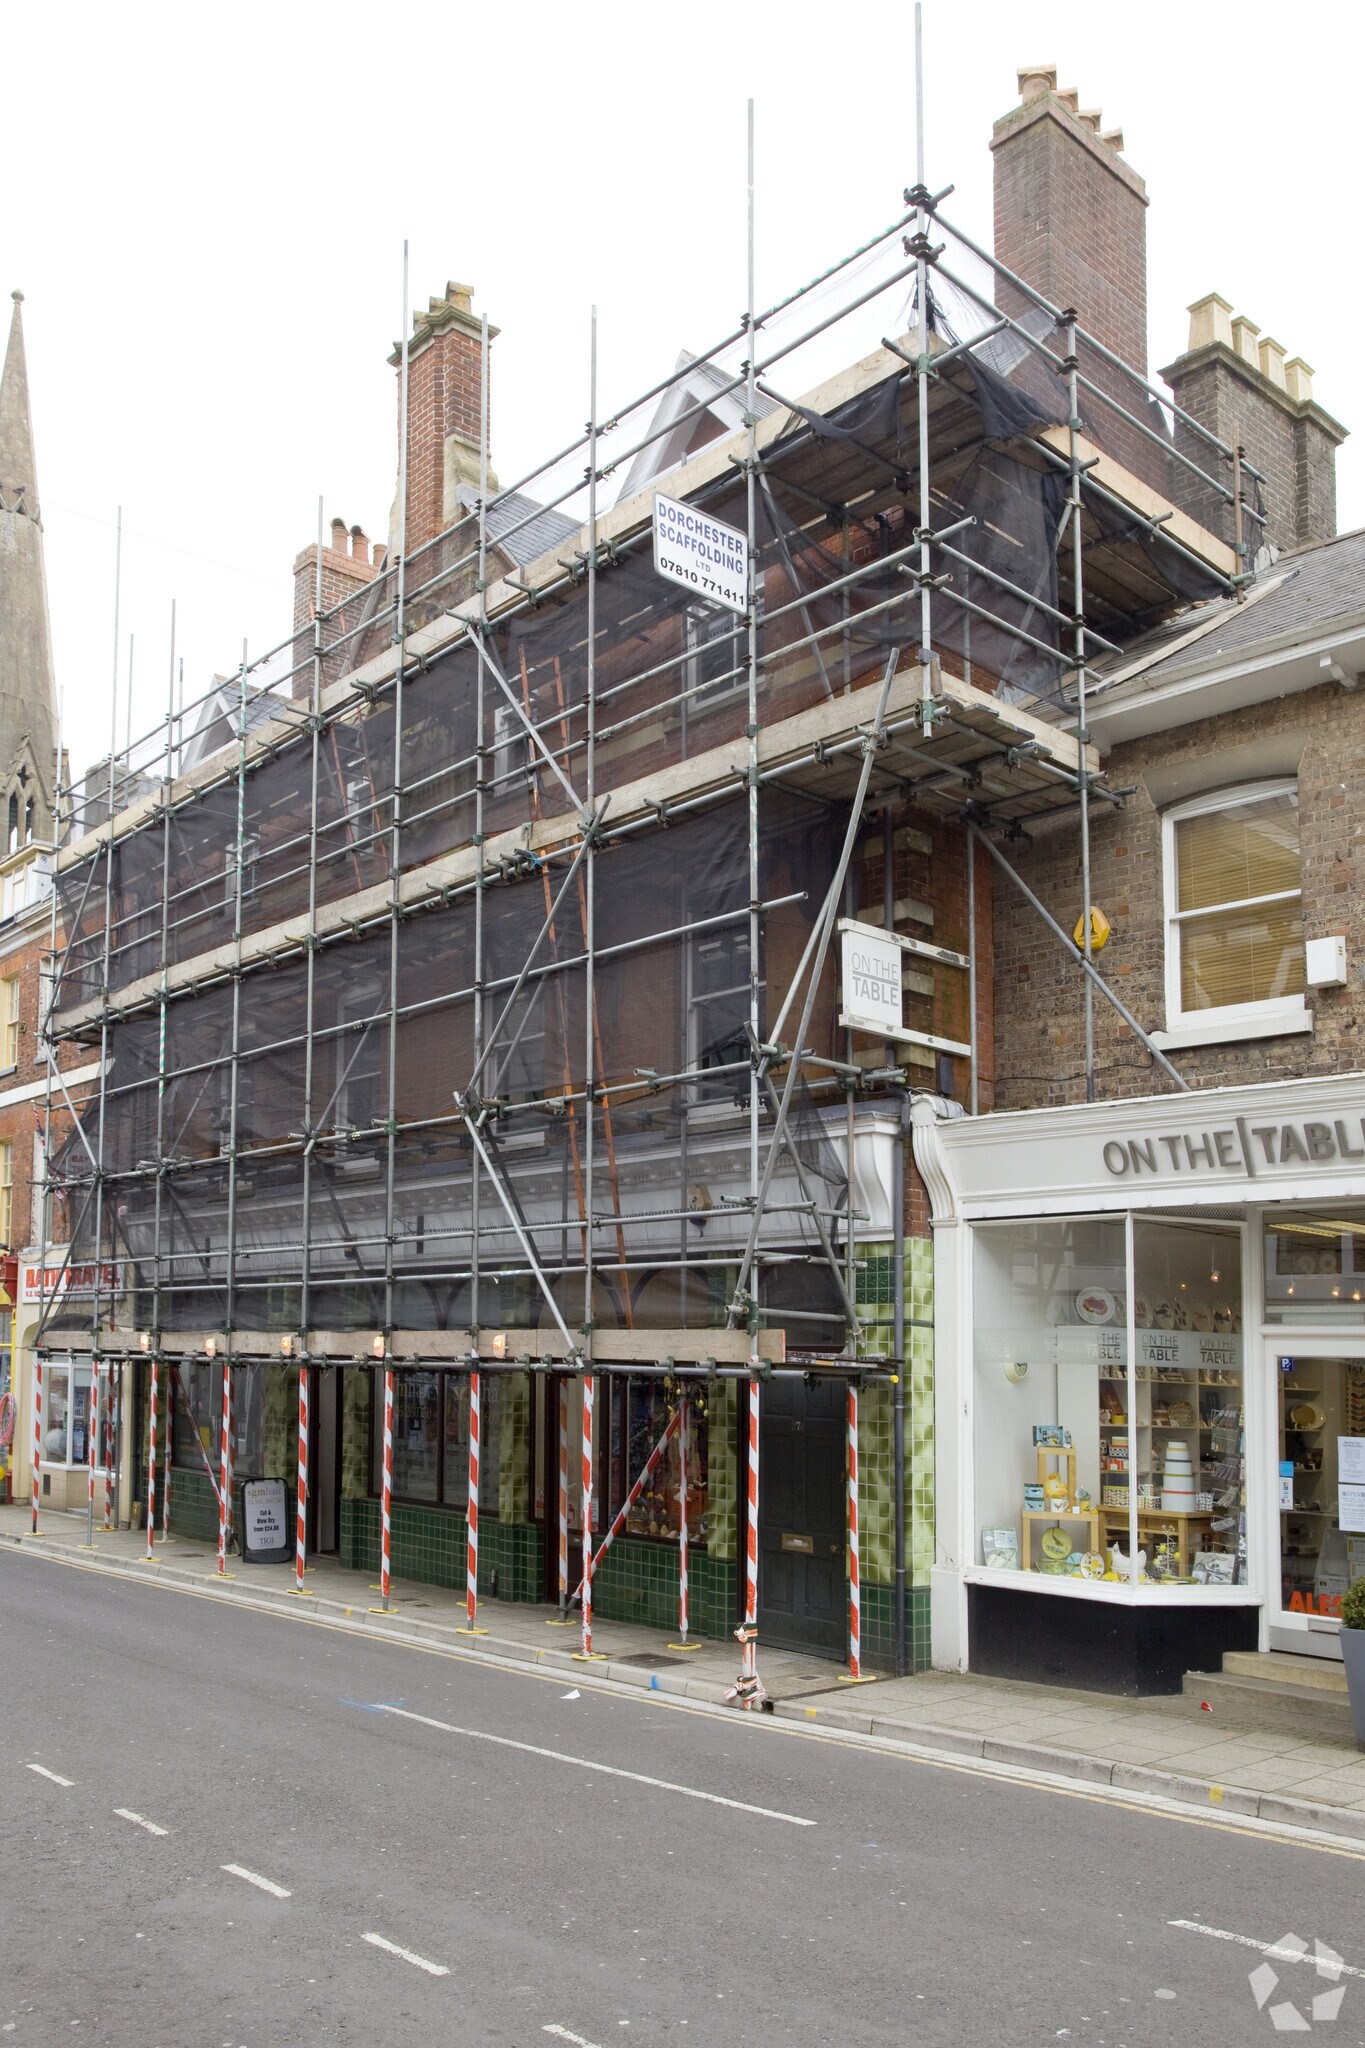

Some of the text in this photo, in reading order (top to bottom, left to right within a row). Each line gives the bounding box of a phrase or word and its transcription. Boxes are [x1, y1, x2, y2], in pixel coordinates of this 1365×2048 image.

[659, 503, 743, 555] DORCHESTER
[660, 523, 743, 575] SCAFFOLDING
[660, 557, 744, 605] 07810 771411
[695, 560, 711, 573] LTD
[851, 952, 899, 982] ON THE
[852, 976, 899, 1007] TABLE
[1102, 1137, 1158, 1176] ON
[1158, 1130, 1242, 1171] THE
[1141, 1333, 1179, 1346] ON THE
[1141, 1348, 1179, 1361] TABLE
[1199, 1338, 1215, 1348] ON
[1200, 1351, 1237, 1364] TABLE
